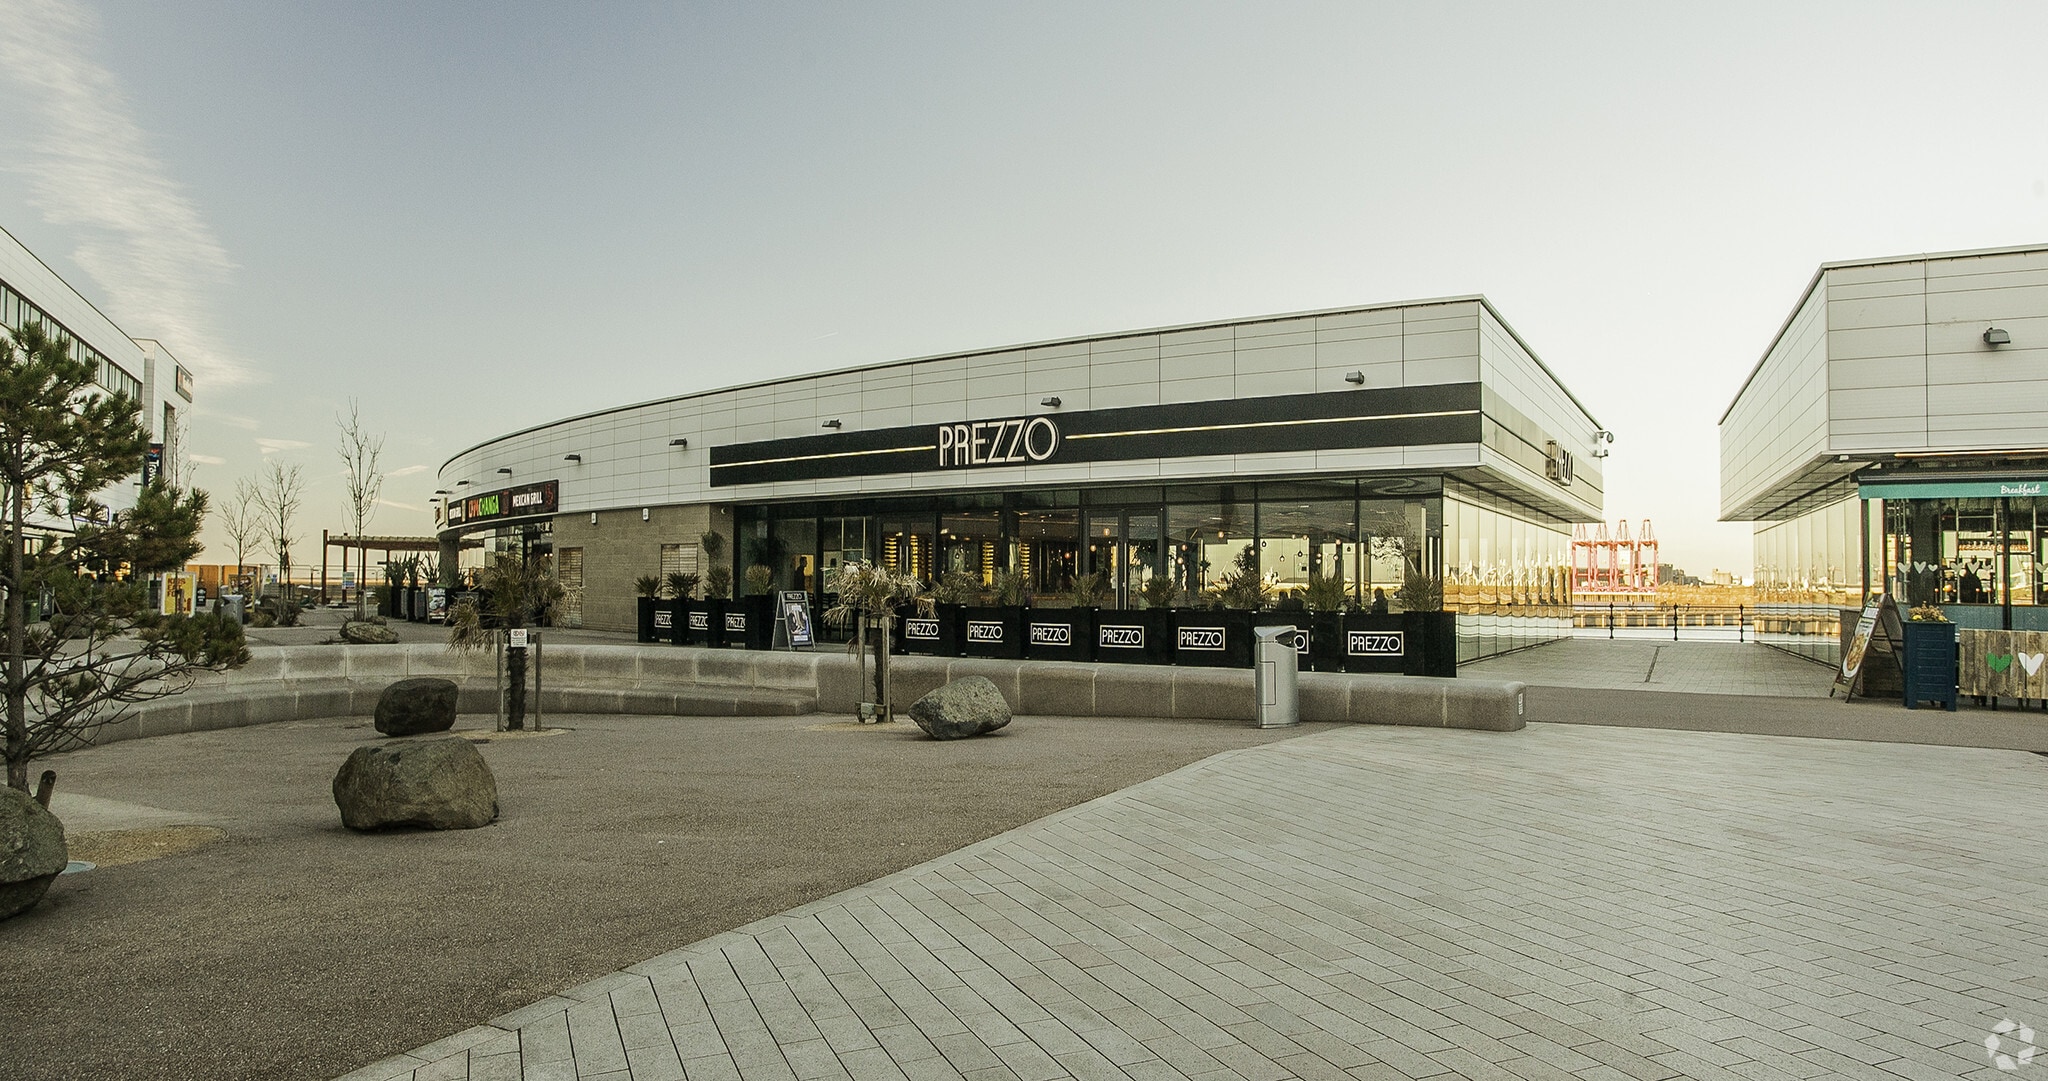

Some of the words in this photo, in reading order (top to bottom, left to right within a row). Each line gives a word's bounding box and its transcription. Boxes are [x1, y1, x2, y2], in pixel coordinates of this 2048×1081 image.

[939, 417, 1059, 467] PREZZO
[2000, 483, 2041, 497] Breakfast
[907, 622, 939, 636] PREZZO
[969, 624, 1003, 639] PREZZO
[1032, 627, 1069, 642] PREZZO
[1102, 629, 1142, 644] PREZZO
[1180, 631, 1223, 646] PREZZO
[1351, 636, 1401, 652] PREZZO
